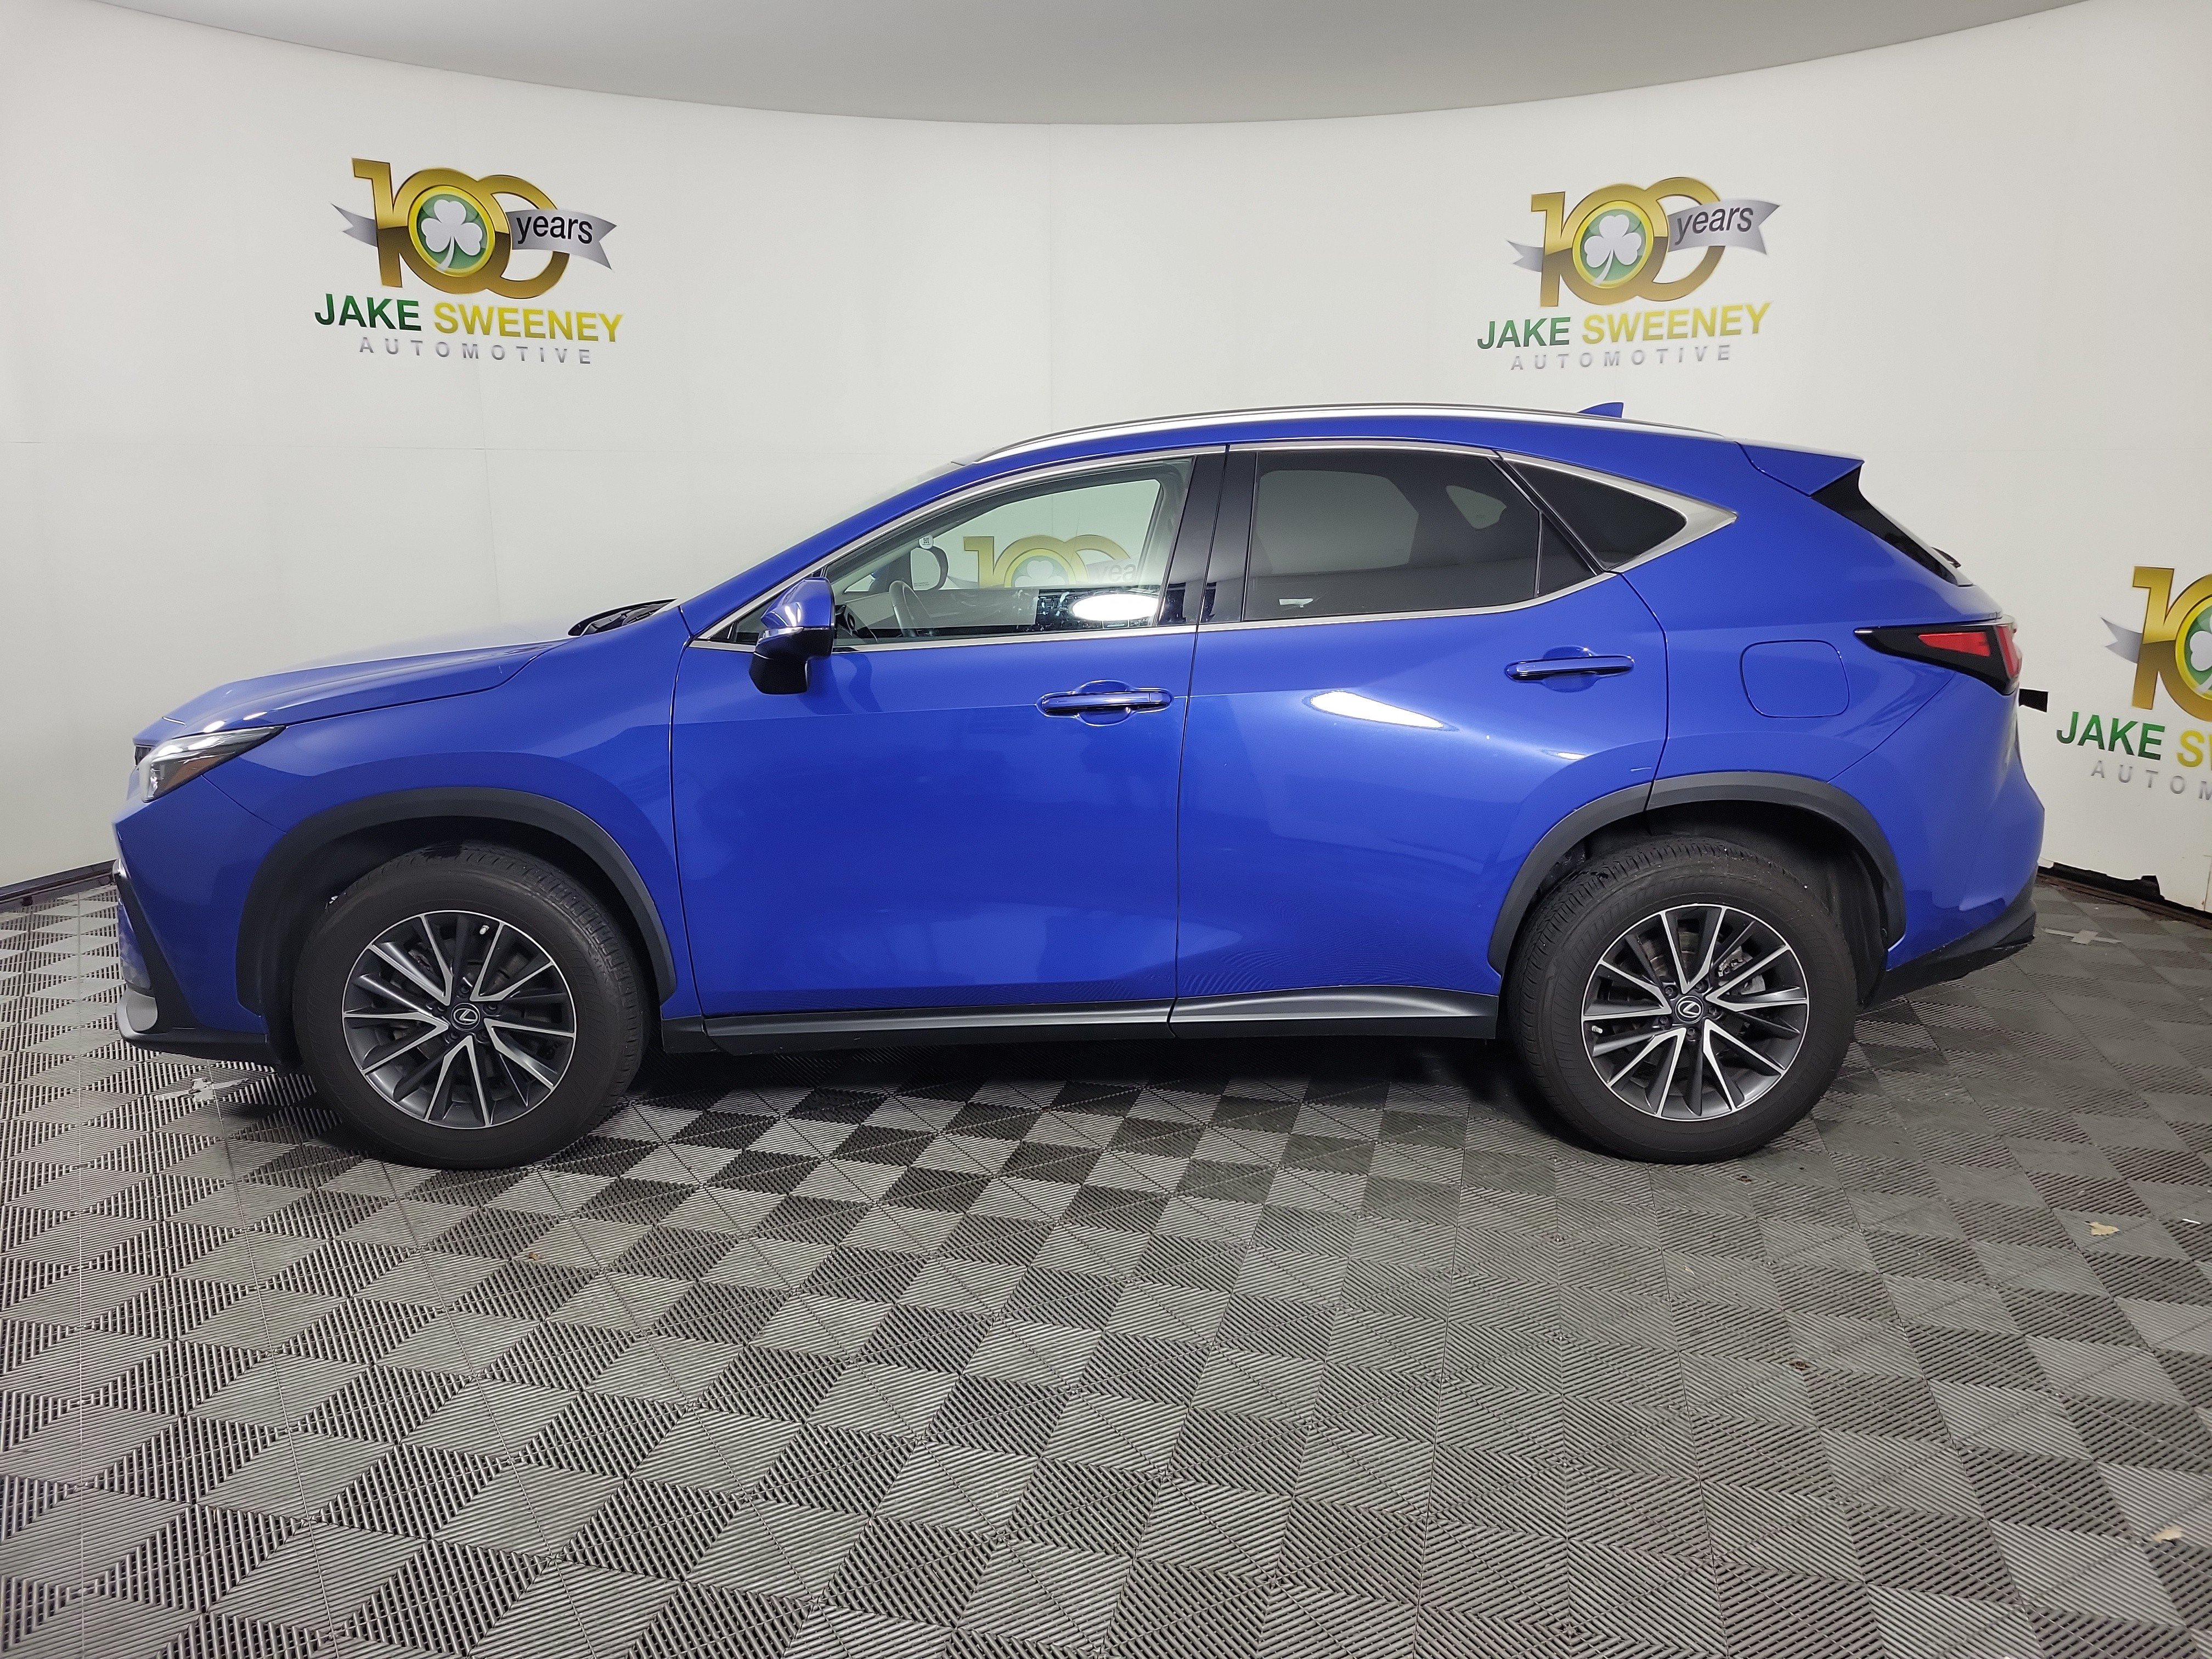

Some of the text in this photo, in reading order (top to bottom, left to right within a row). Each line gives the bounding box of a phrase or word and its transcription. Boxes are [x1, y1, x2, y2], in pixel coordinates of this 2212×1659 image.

[352, 157, 593, 299] 100 years
[1531, 177, 1754, 307] 100 years
[314, 293, 624, 342] JAKE SWEENEY
[1477, 302, 1771, 349] JAKE SWEENEY
[359, 337, 591, 364] AUTOMOTIVE
[1510, 345, 1731, 370] AUTOMOTIVE
[2057, 711, 2212, 771] JAKE S
